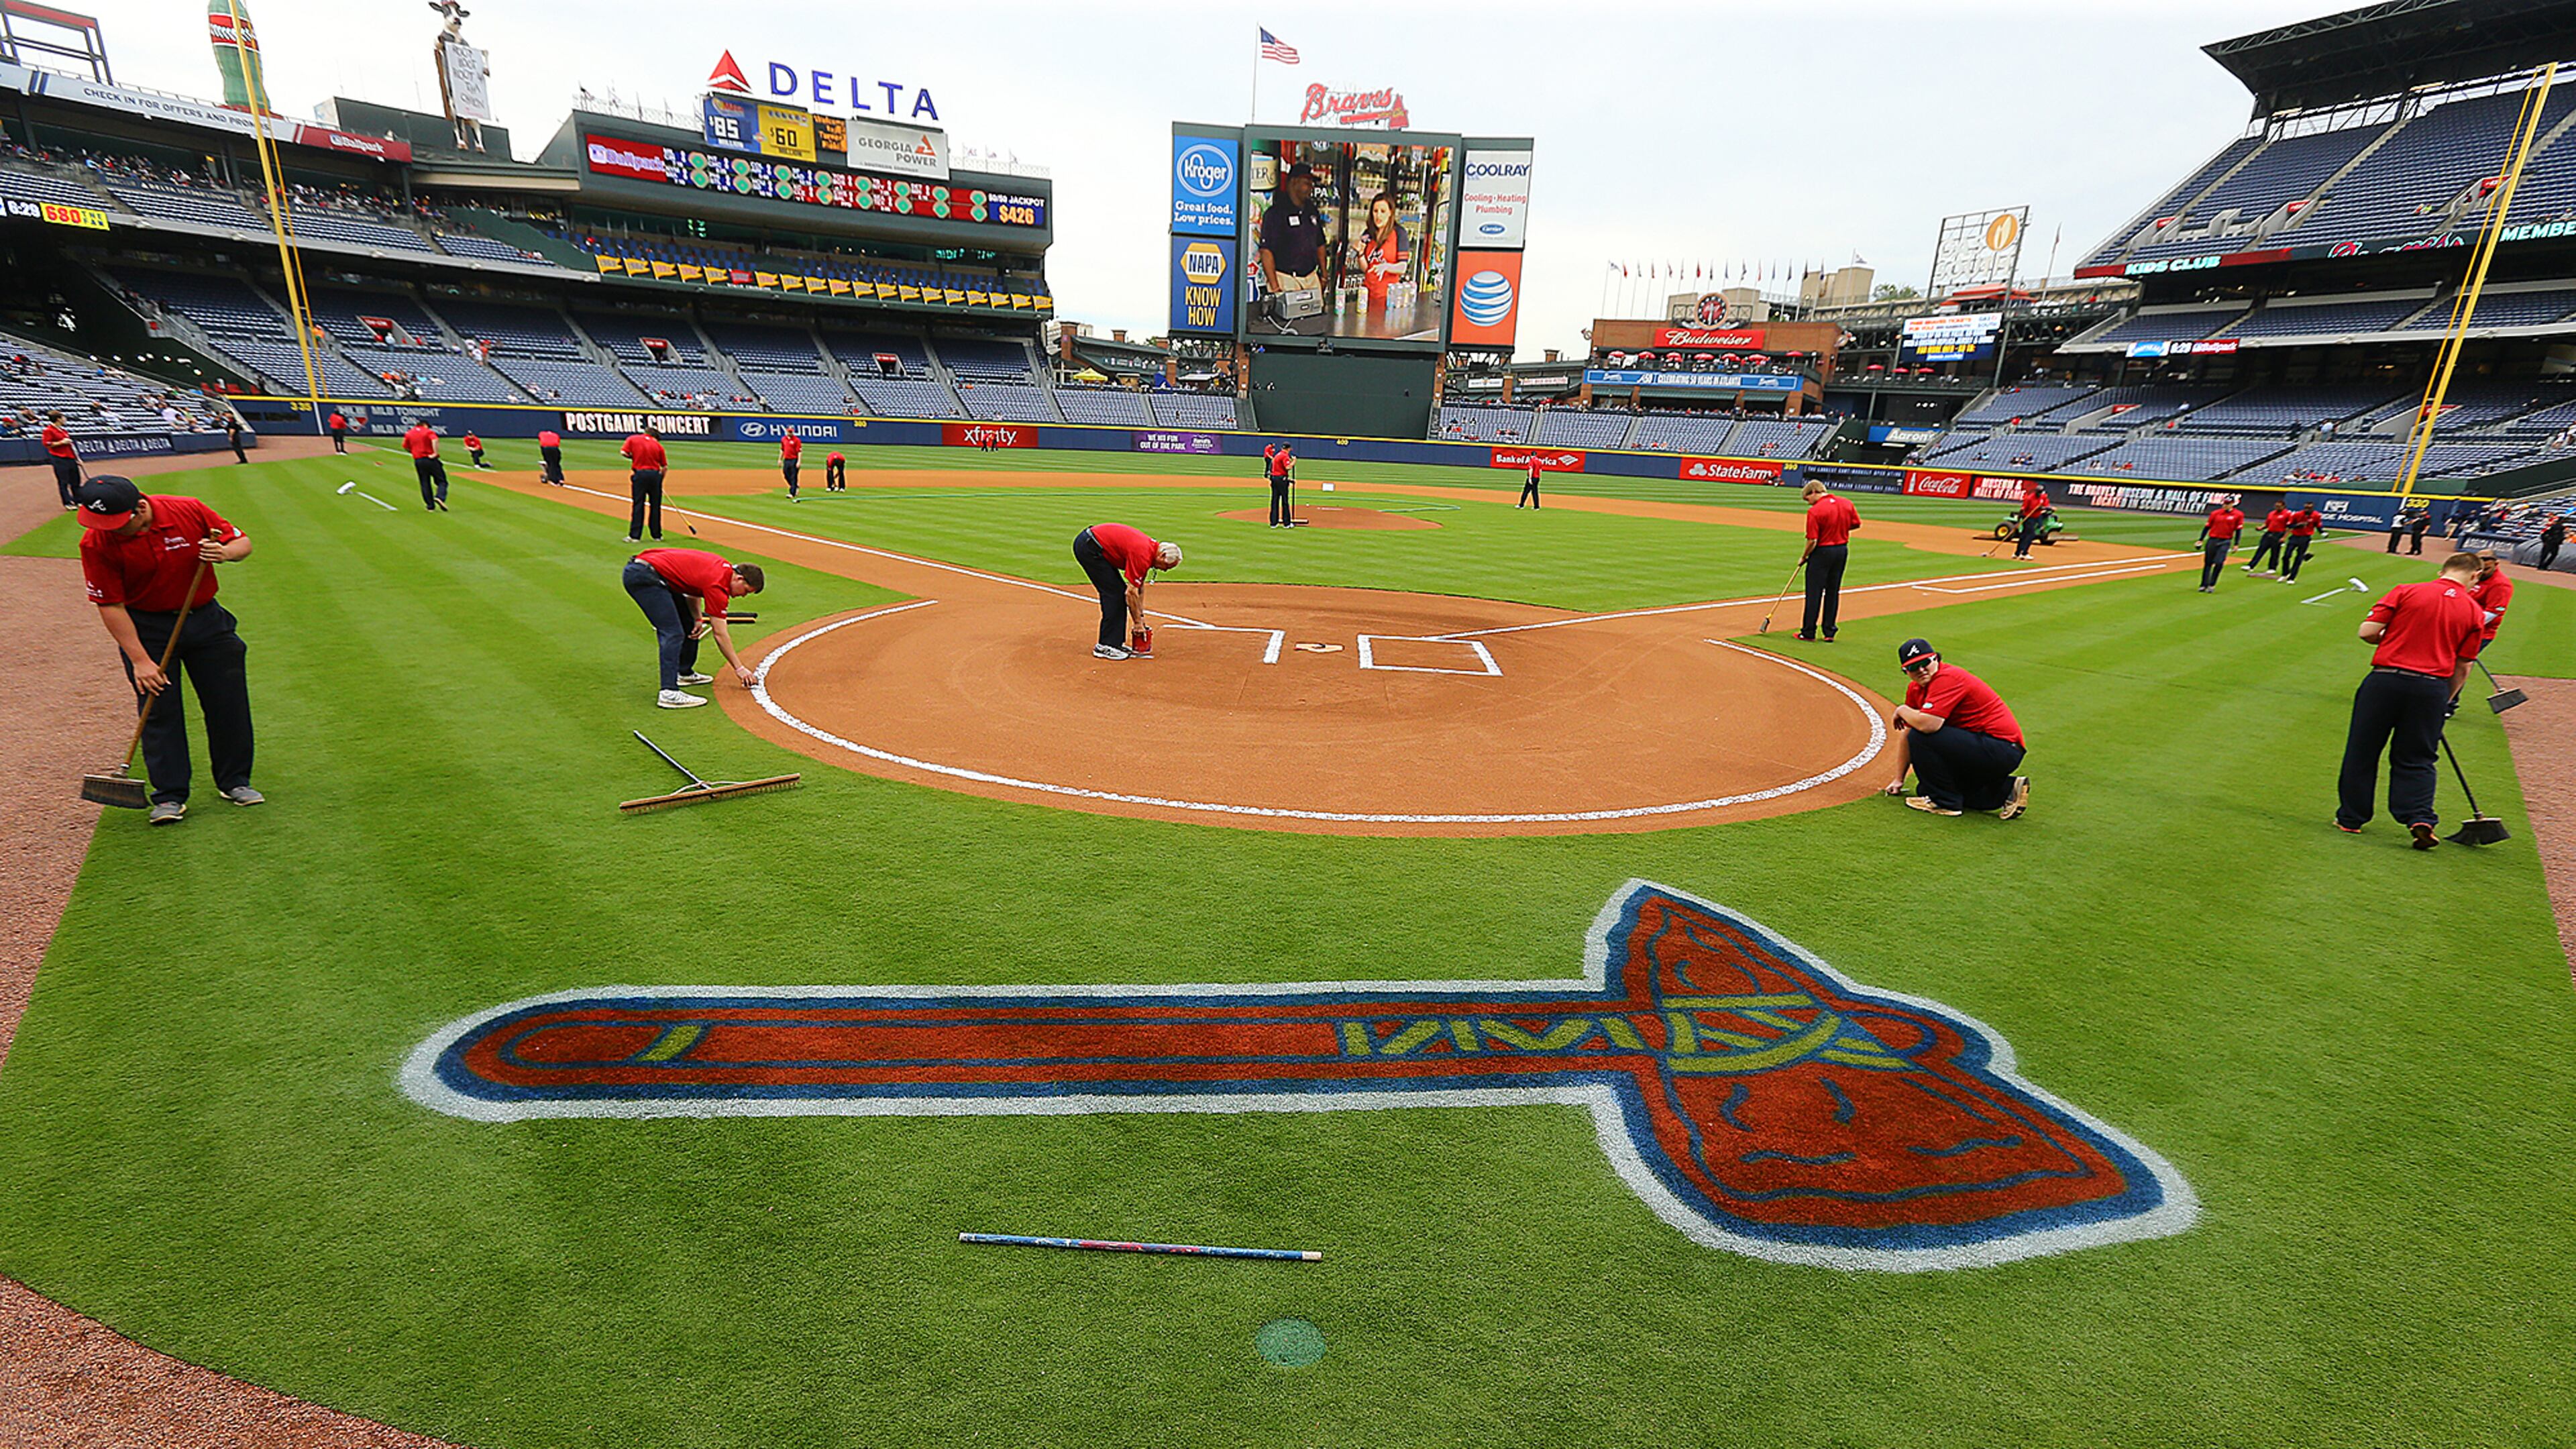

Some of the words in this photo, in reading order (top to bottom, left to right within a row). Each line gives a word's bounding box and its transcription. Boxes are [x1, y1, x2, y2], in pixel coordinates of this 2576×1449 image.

[769, 61, 939, 121] DELTA
[84, 87, 121, 102] CHECK
[123, 95, 136, 105] IN
[138, 99, 160, 111] FOR
[163, 103, 202, 120] OFFERS
[205, 111, 227, 123] AND
[1300, 83, 1393, 124] Braves
[708, 116, 741, 140] $85
[770, 127, 797, 147] $60
[859, 137, 912, 153] GEORGIA
[896, 152, 936, 167] POWER
[1184, 153, 1227, 190] Kroger
[1466, 162, 1530, 176] COOLRAY
[1008, 195, 1045, 207] JACKPOT
[1464, 193, 1493, 203] Cooling
[1497, 194, 1527, 204] Heating
[7, 201, 40, 218] 6:29
[46, 205, 81, 223] 680
[999, 205, 1034, 225] $426
[1175, 201, 1205, 212] Great
[1207, 203, 1233, 214] food.
[1476, 205, 1513, 215] Plumbing
[1174, 212, 1195, 222] Low
[1198, 214, 1234, 225] prices.
[1189, 254, 1219, 274] NAPA
[2125, 260, 2169, 275] KIDS
[2170, 256, 2221, 271] CLUB
[1185, 286, 1222, 307] KNOW
[1188, 306, 1216, 326] HOW
[1665, 329, 1752, 345] Budweiser
[1658, 374, 1690, 385] CELEBRATING
[1719, 376, 1741, 386] ATLANTA
[290, 401, 313, 411] 335
[371, 406, 394, 416] MLB
[395, 407, 441, 417] TONIGHT
[371, 424, 394, 434] MLB
[566, 413, 645, 433] POSTGAME
[647, 415, 710, 435] CONCERT
[76, 439, 107, 453] DELTA
[114, 439, 142, 451] DELTA
[146, 437, 172, 449] DELTA
[1496, 454, 1516, 464] Bank
[1516, 455, 1524, 464] of
[1523, 456, 1557, 466] Arica
[1708, 464, 1739, 478] State
[1739, 466, 1772, 480] Farm
[1919, 476, 1963, 494] Coca-Cola
[1982, 477, 2015, 489] MUSEUM
[2015, 479, 2023, 490] &
[1974, 487, 1992, 497] HALL
[1993, 488, 2004, 498] OF
[2004, 489, 2027, 500] FAME
[2068, 484, 2085, 495] THE
[2084, 484, 2116, 496] BRAVES
[2116, 486, 2155, 498] MUSEUM
[2155, 488, 2164, 500] &
[2165, 490, 2187, 502] HALL
[2188, 490, 2202, 503] OF
[2203, 492, 2229, 504] FAME
[2091, 496, 2127, 508] LOCATED
[2127, 498, 2139, 508] IN
[2139, 498, 2174, 511] SCOUTS
[2174, 502, 2207, 513] ALLEY!
[2406, 498, 2430, 508] 330
[2337, 514, 2383, 524] HOSPITAL
